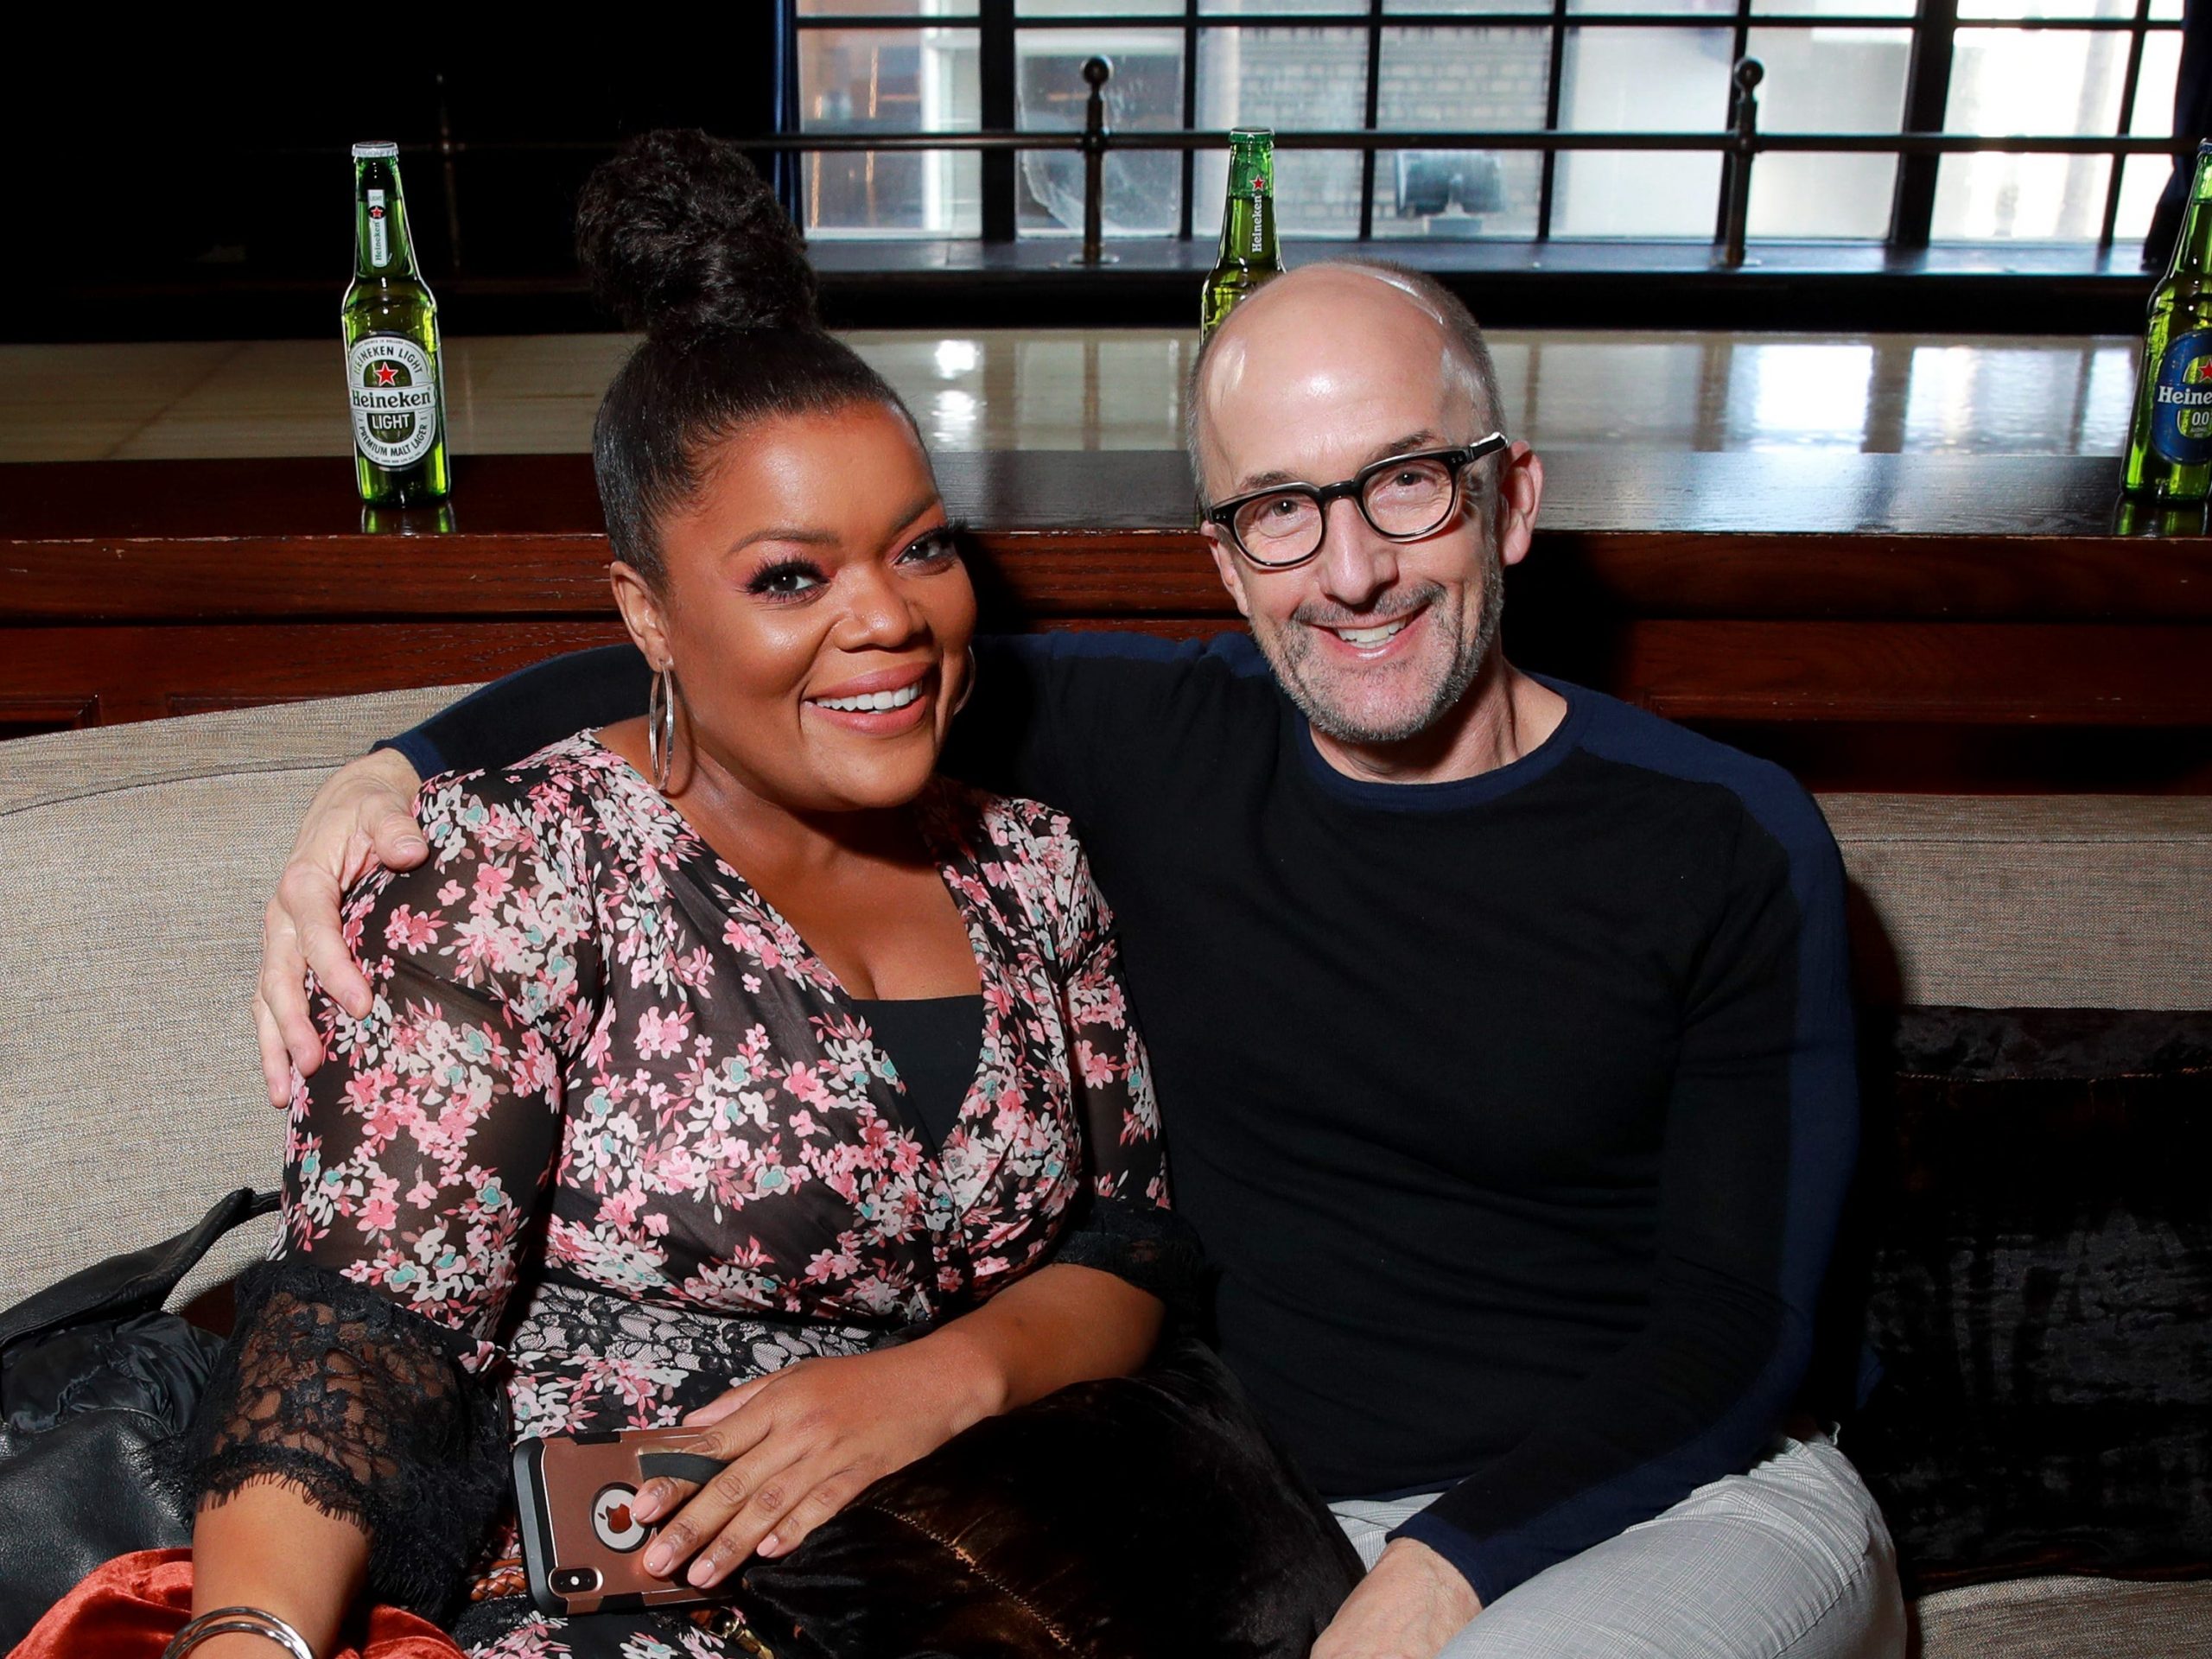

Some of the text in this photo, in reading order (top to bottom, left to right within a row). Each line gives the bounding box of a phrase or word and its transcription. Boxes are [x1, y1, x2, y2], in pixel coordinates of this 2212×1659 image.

[1252, 194, 1262, 252] Heineken
[353, 346, 423, 375] HEINEKEN LIGHT
[353, 391, 431, 409] Heineken
[2158, 385, 2212, 405] Heine
[372, 414, 410, 429] LIGHT
[359, 426, 387, 456] PREMIUM
[391, 443, 411, 457] MALT
[411, 423, 429, 449] LAGER
